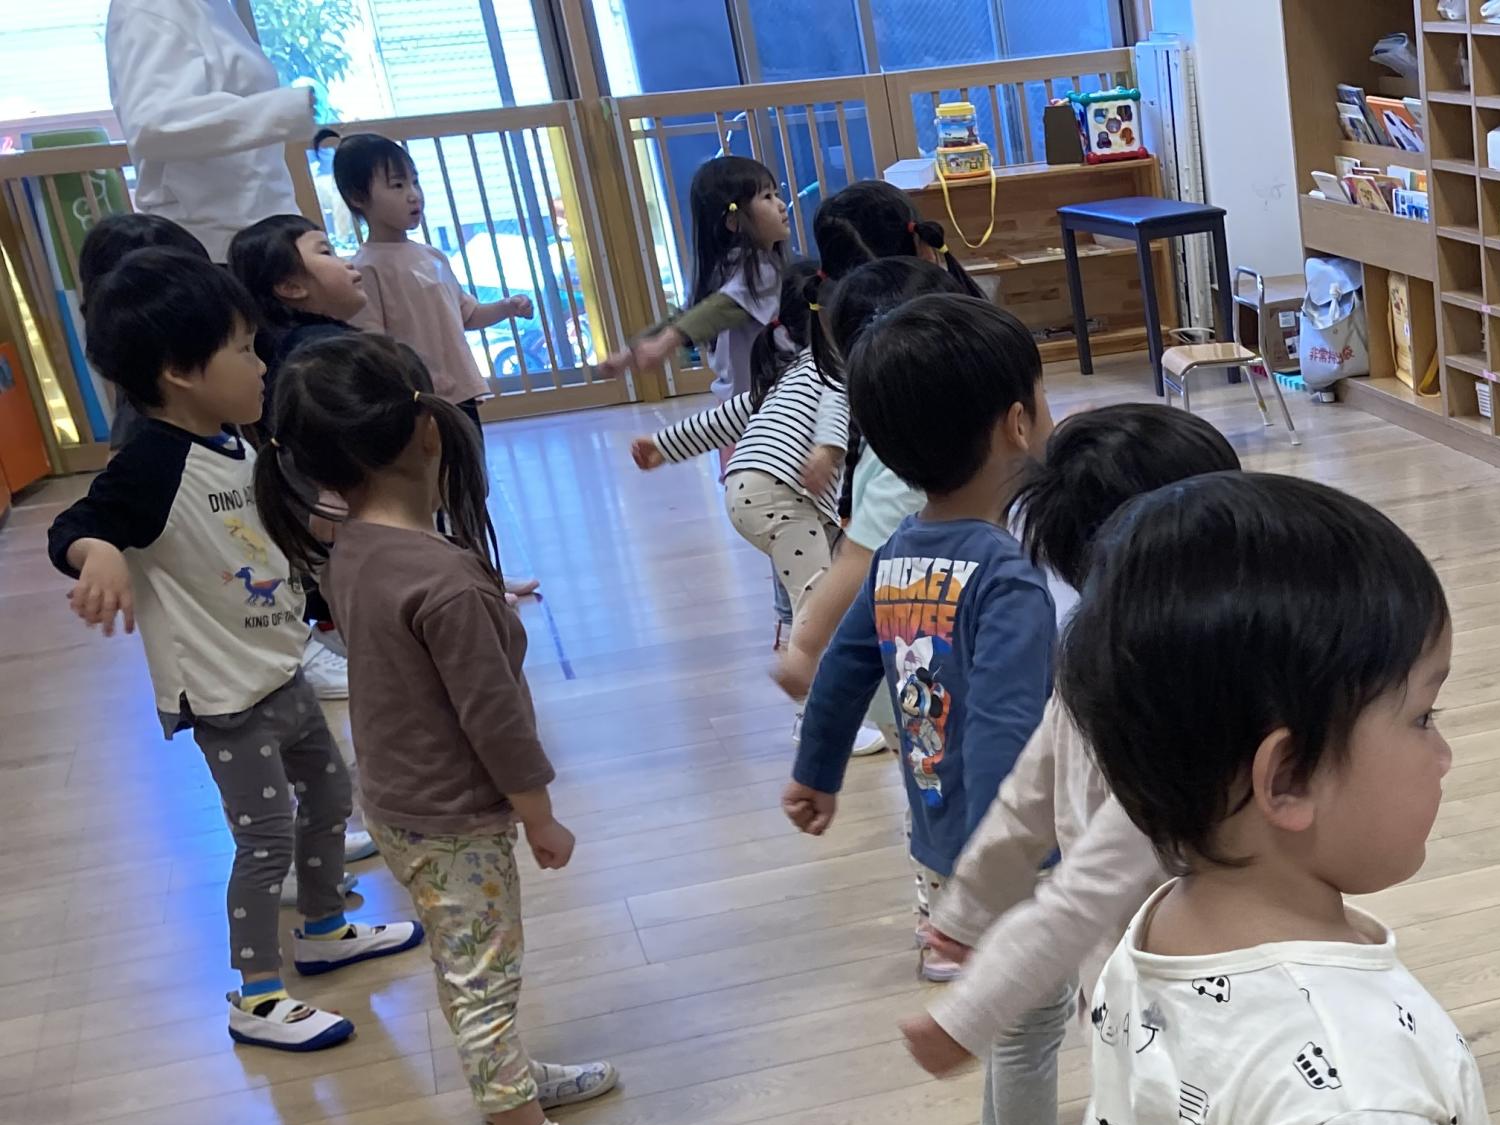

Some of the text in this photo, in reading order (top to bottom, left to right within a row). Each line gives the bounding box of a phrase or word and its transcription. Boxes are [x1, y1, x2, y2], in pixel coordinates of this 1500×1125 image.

[208, 489, 243, 512] DINO
[875, 557, 979, 601] MICKEY
[245, 615, 269, 628] KING
[272, 612, 282, 626] OF
